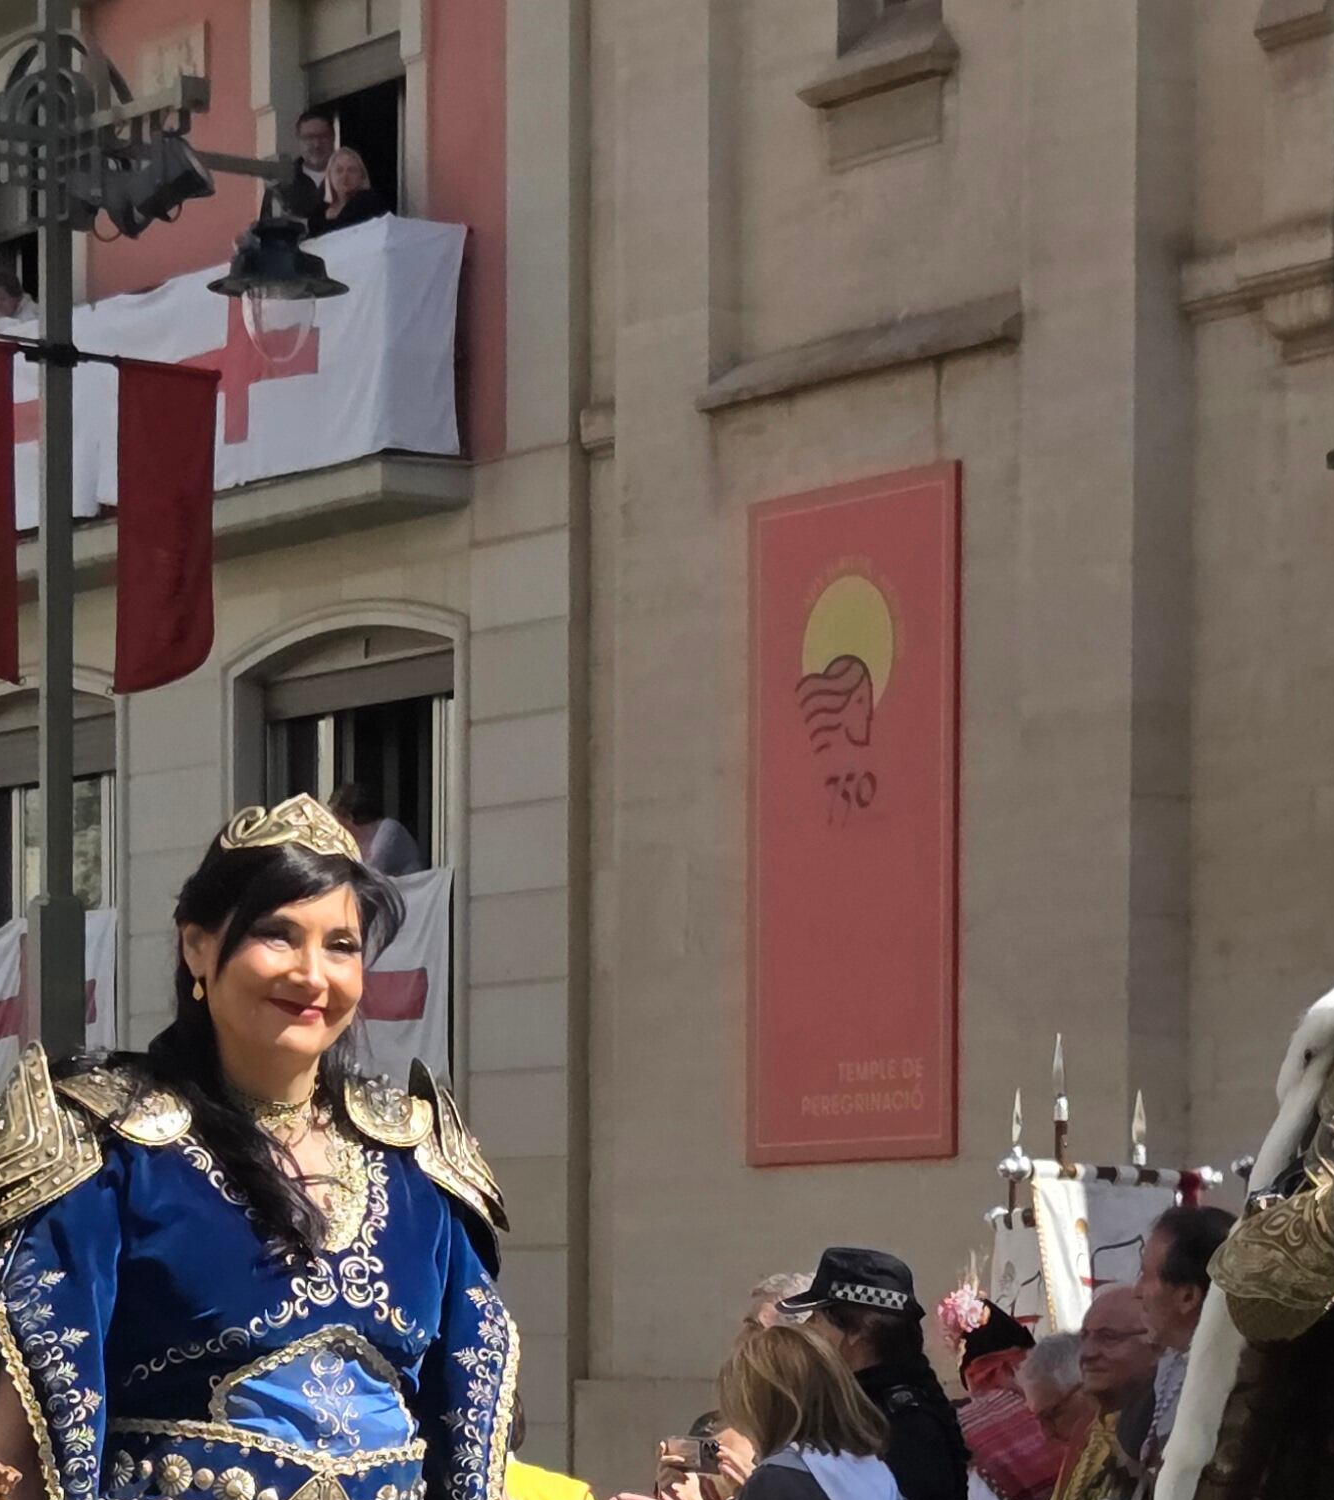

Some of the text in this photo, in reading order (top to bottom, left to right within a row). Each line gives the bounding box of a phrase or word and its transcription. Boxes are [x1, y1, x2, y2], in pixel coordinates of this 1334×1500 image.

[825, 771, 877, 828] 750
[838, 1056, 924, 1083] TEMPLE DE
[801, 1082, 924, 1117] PEREGRINACIÓ
